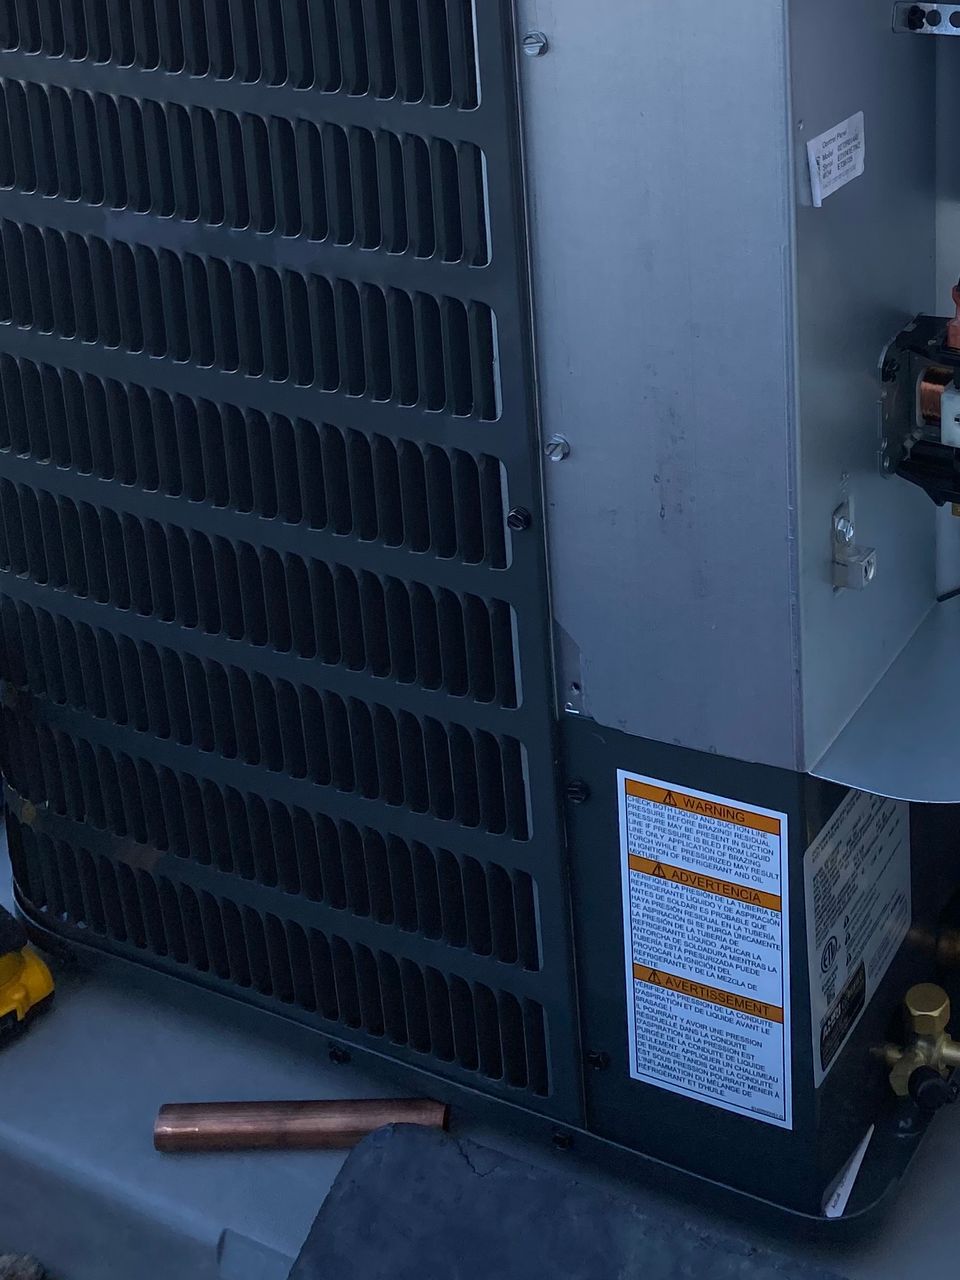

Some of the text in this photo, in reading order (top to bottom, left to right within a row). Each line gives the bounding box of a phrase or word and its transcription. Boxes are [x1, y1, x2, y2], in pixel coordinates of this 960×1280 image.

[627, 803, 664, 819] PRESSURE
[667, 814, 696, 827] BEFORE
[734, 832, 768, 847] RESIDUAL
[653, 802, 767, 839] BOTH AND SUCTION LINE
[683, 796, 744, 823] WARNING
[628, 810, 773, 856] PRESSURE MAY BE PRESENT SUCTION
[628, 818, 770, 862] LINE PRESSURE BLED FROM LIQUID
[628, 825, 760, 867] LINE APPLICATION OF BRAZING
[629, 832, 778, 880] TORCH WHILE PRESSURIZED MAY RESULT
[638, 842, 762, 883] IGNITION OF REFRIGERANT AND OIL
[630, 878, 683, 899] REFRIGERANTE
[723, 904, 733, 914] DE
[670, 882, 679, 890] LA
[715, 894, 723, 903] DE
[726, 897, 735, 906] LA
[770, 910, 780, 919] DE
[671, 868, 761, 904] ADVERTENCIA
[631, 886, 653, 898] ANTES
[655, 893, 664, 901] DE
[699, 906, 708, 914] ES
[711, 909, 748, 926] PROBABLE
[751, 921, 766, 931] QUE
[631, 893, 649, 905] HAYA
[684, 908, 719, 925] RESIDUAL
[721, 919, 731, 928] EN
[733, 923, 741, 931] LA
[631, 901, 640, 910] DE
[695, 920, 704, 928] SE
[706, 923, 731, 937] PURGA
[632, 909, 640, 918] LA
[674, 921, 683, 930] DE
[686, 925, 694, 933] LA
[729, 937, 738, 946] DE
[632, 917, 761, 961] REFRIGERANTE APLICAR LA
[632, 924, 776, 973] ANTORCHA DE SOLDADURA MIENTRAS LA
[633, 940, 671, 957] PROVOCAR
[673, 952, 681, 960] LA
[717, 965, 731, 975] DEL
[633, 948, 757, 991] REFRIGERANTE DE LA MEZCLA DE
[634, 955, 657, 968] ACEITE
[683, 947, 733, 968] PRESURIZADA
[735, 962, 759, 976] PUEDE
[635, 995, 667, 1011] BRASAGE
[635, 987, 769, 1035] D'ASPIRATION ET DE LIQUIDE AVANT LE
[665, 975, 769, 1017] AVERTISSEMENT
[666, 989, 772, 1028] LA PRESSION DE LA CONDUITE
[636, 1018, 754, 1061] D'ASPIRATION LA PRESSION EST
[643, 1005, 762, 1048] POURRAIT AVOIR UNE PRESSION
[679, 1023, 698, 1035] DANS
[700, 1030, 708, 1039] LA
[711, 1033, 746, 1051] CONDUITE
[637, 1040, 772, 1089] DE BRASAGE QUE LA CONDUITE
[638, 1047, 773, 1097] EST SOUS PRESSION POURRAIT MENER
[666, 1034, 674, 1043] DE
[677, 1038, 686, 1046] LA
[688, 1041, 723, 1058] CONDUITE
[725, 1053, 734, 1062] DE
[736, 1056, 765, 1072] LIQUIDE
[681, 1047, 778, 1083] APPLIQUER UN CHALUMEAU
[638, 1054, 693, 1078] L'INFLAMMATION
[695, 1073, 704, 1082] DU
[742, 1088, 752, 1098] DE
[687, 1078, 724, 1096] ET D'HUILE
